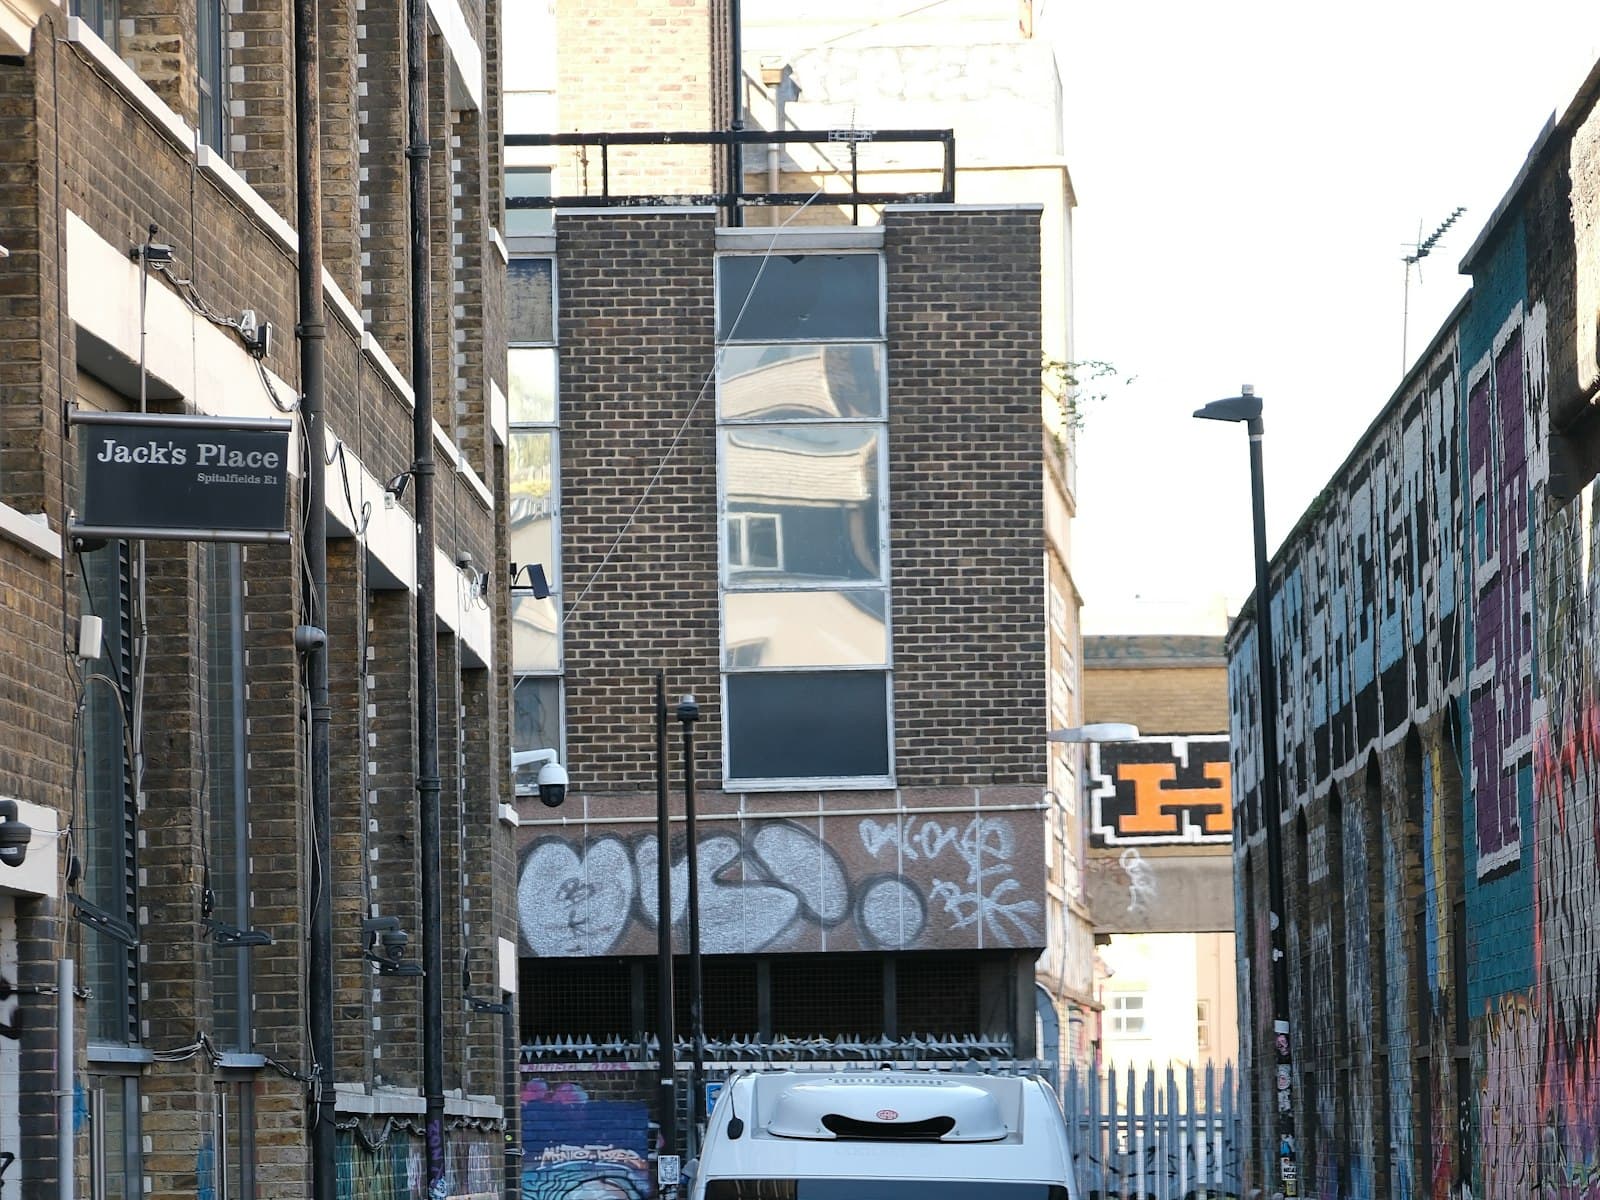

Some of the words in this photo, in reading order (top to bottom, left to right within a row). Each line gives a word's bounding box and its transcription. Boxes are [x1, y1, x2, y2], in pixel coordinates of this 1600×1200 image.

[97, 439, 187, 465] Jack's
[196, 443, 279, 468] Place
[197, 472, 261, 485] Spitalfields
[264, 475, 278, 485] E1
